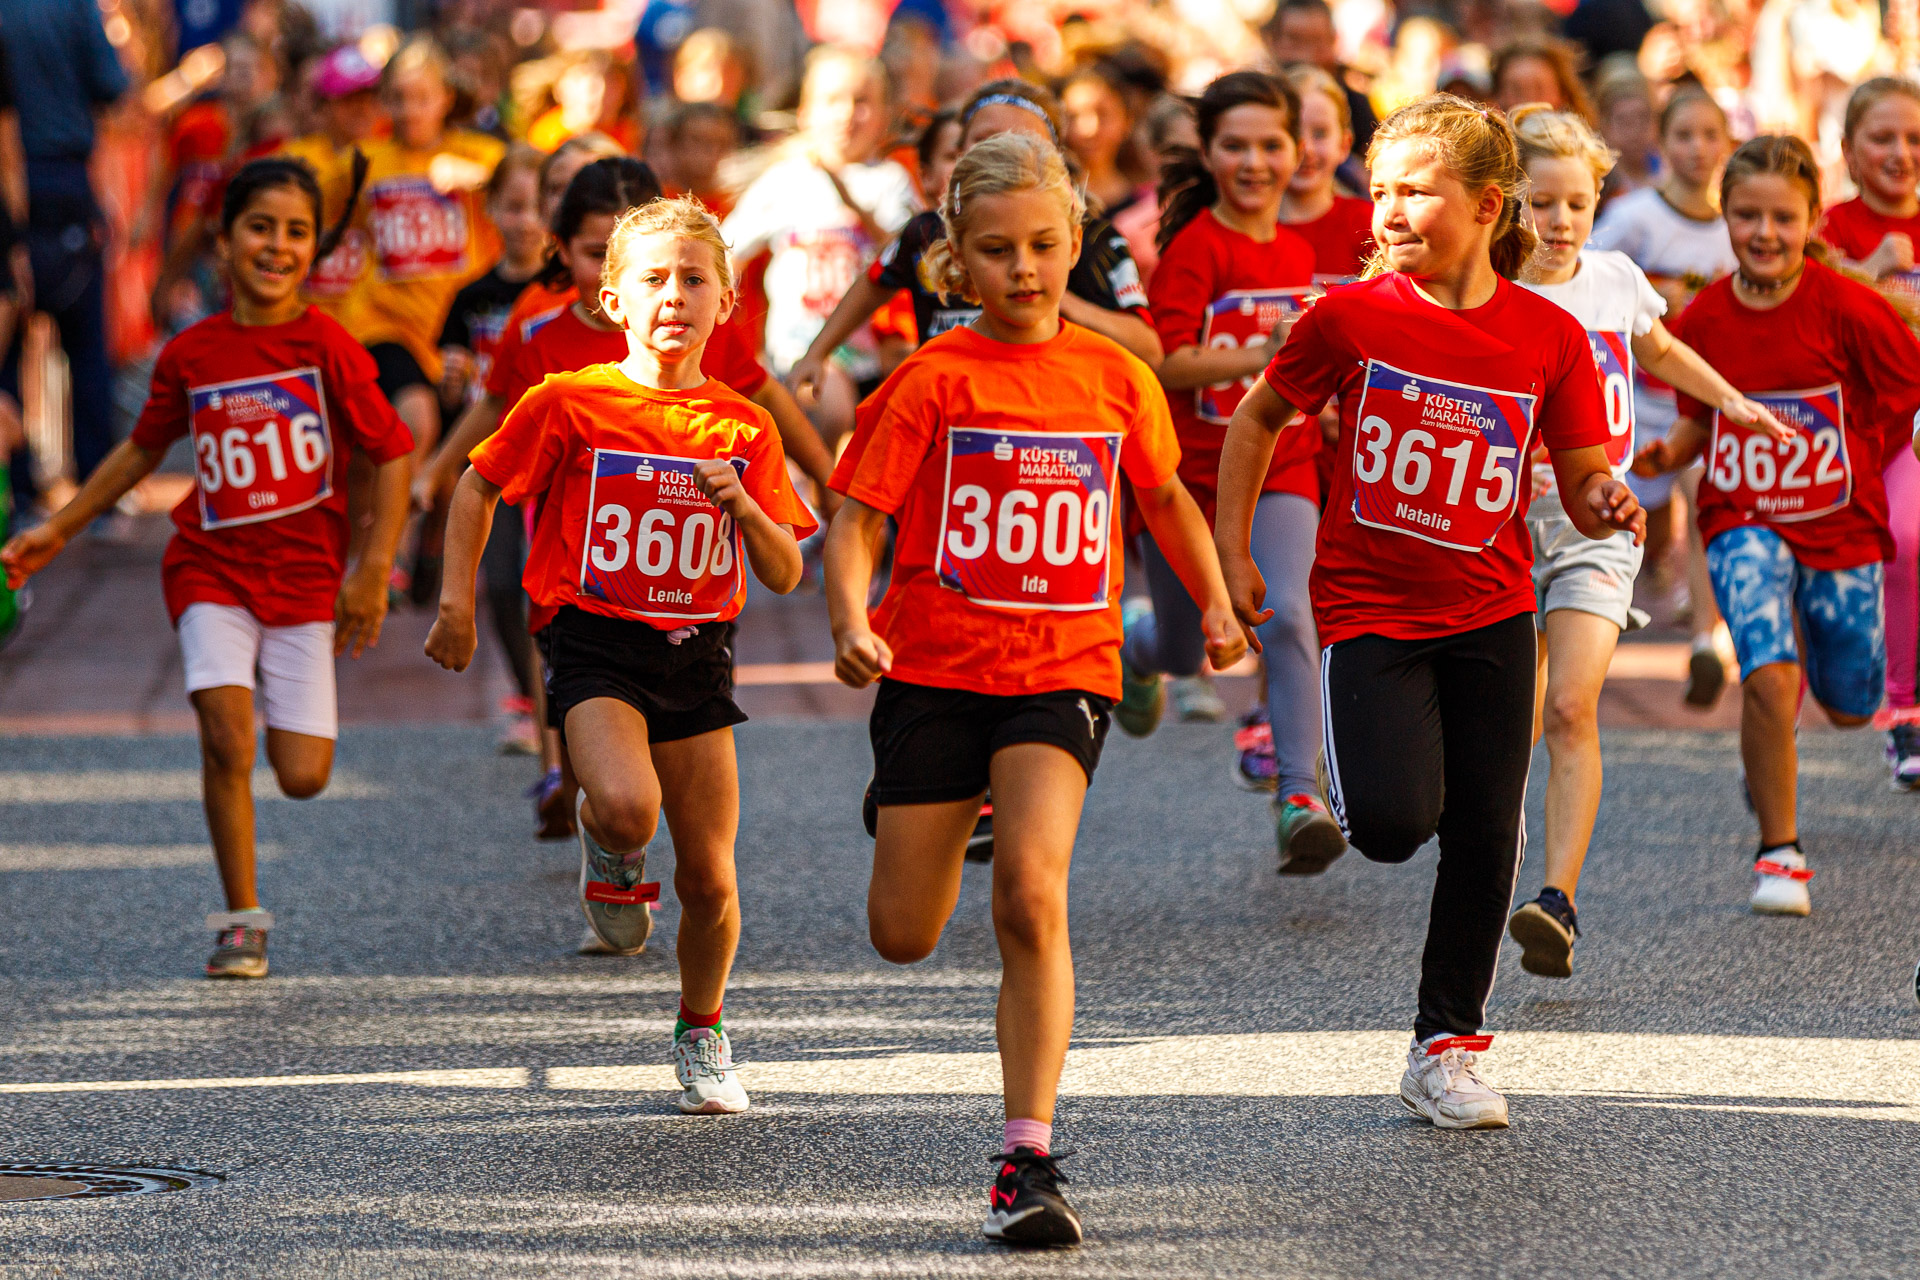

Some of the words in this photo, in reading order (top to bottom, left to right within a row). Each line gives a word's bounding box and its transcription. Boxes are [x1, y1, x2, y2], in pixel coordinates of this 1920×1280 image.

[1425, 393, 1482, 415] KÜSTEN
[1420, 419, 1435, 427] zum
[1436, 421, 1480, 437] Weltkindertag
[1422, 406, 1496, 431] MARATHON
[199, 412, 326, 493] 3616
[1019, 446, 1078, 464] KÜSTEN
[1714, 426, 1844, 493] 3622
[1019, 463, 1092, 477] MARATHON
[1356, 415, 1517, 513] 3615
[659, 469, 694, 486] KÜST
[1019, 477, 1034, 485] zum
[1035, 477, 1080, 487] Weltkindertag
[948, 484, 1108, 566] 3609
[1396, 502, 1451, 532] Natalie
[591, 503, 733, 580] 3608
[648, 586, 693, 605] Lenke
[1022, 575, 1048, 594] Ida
